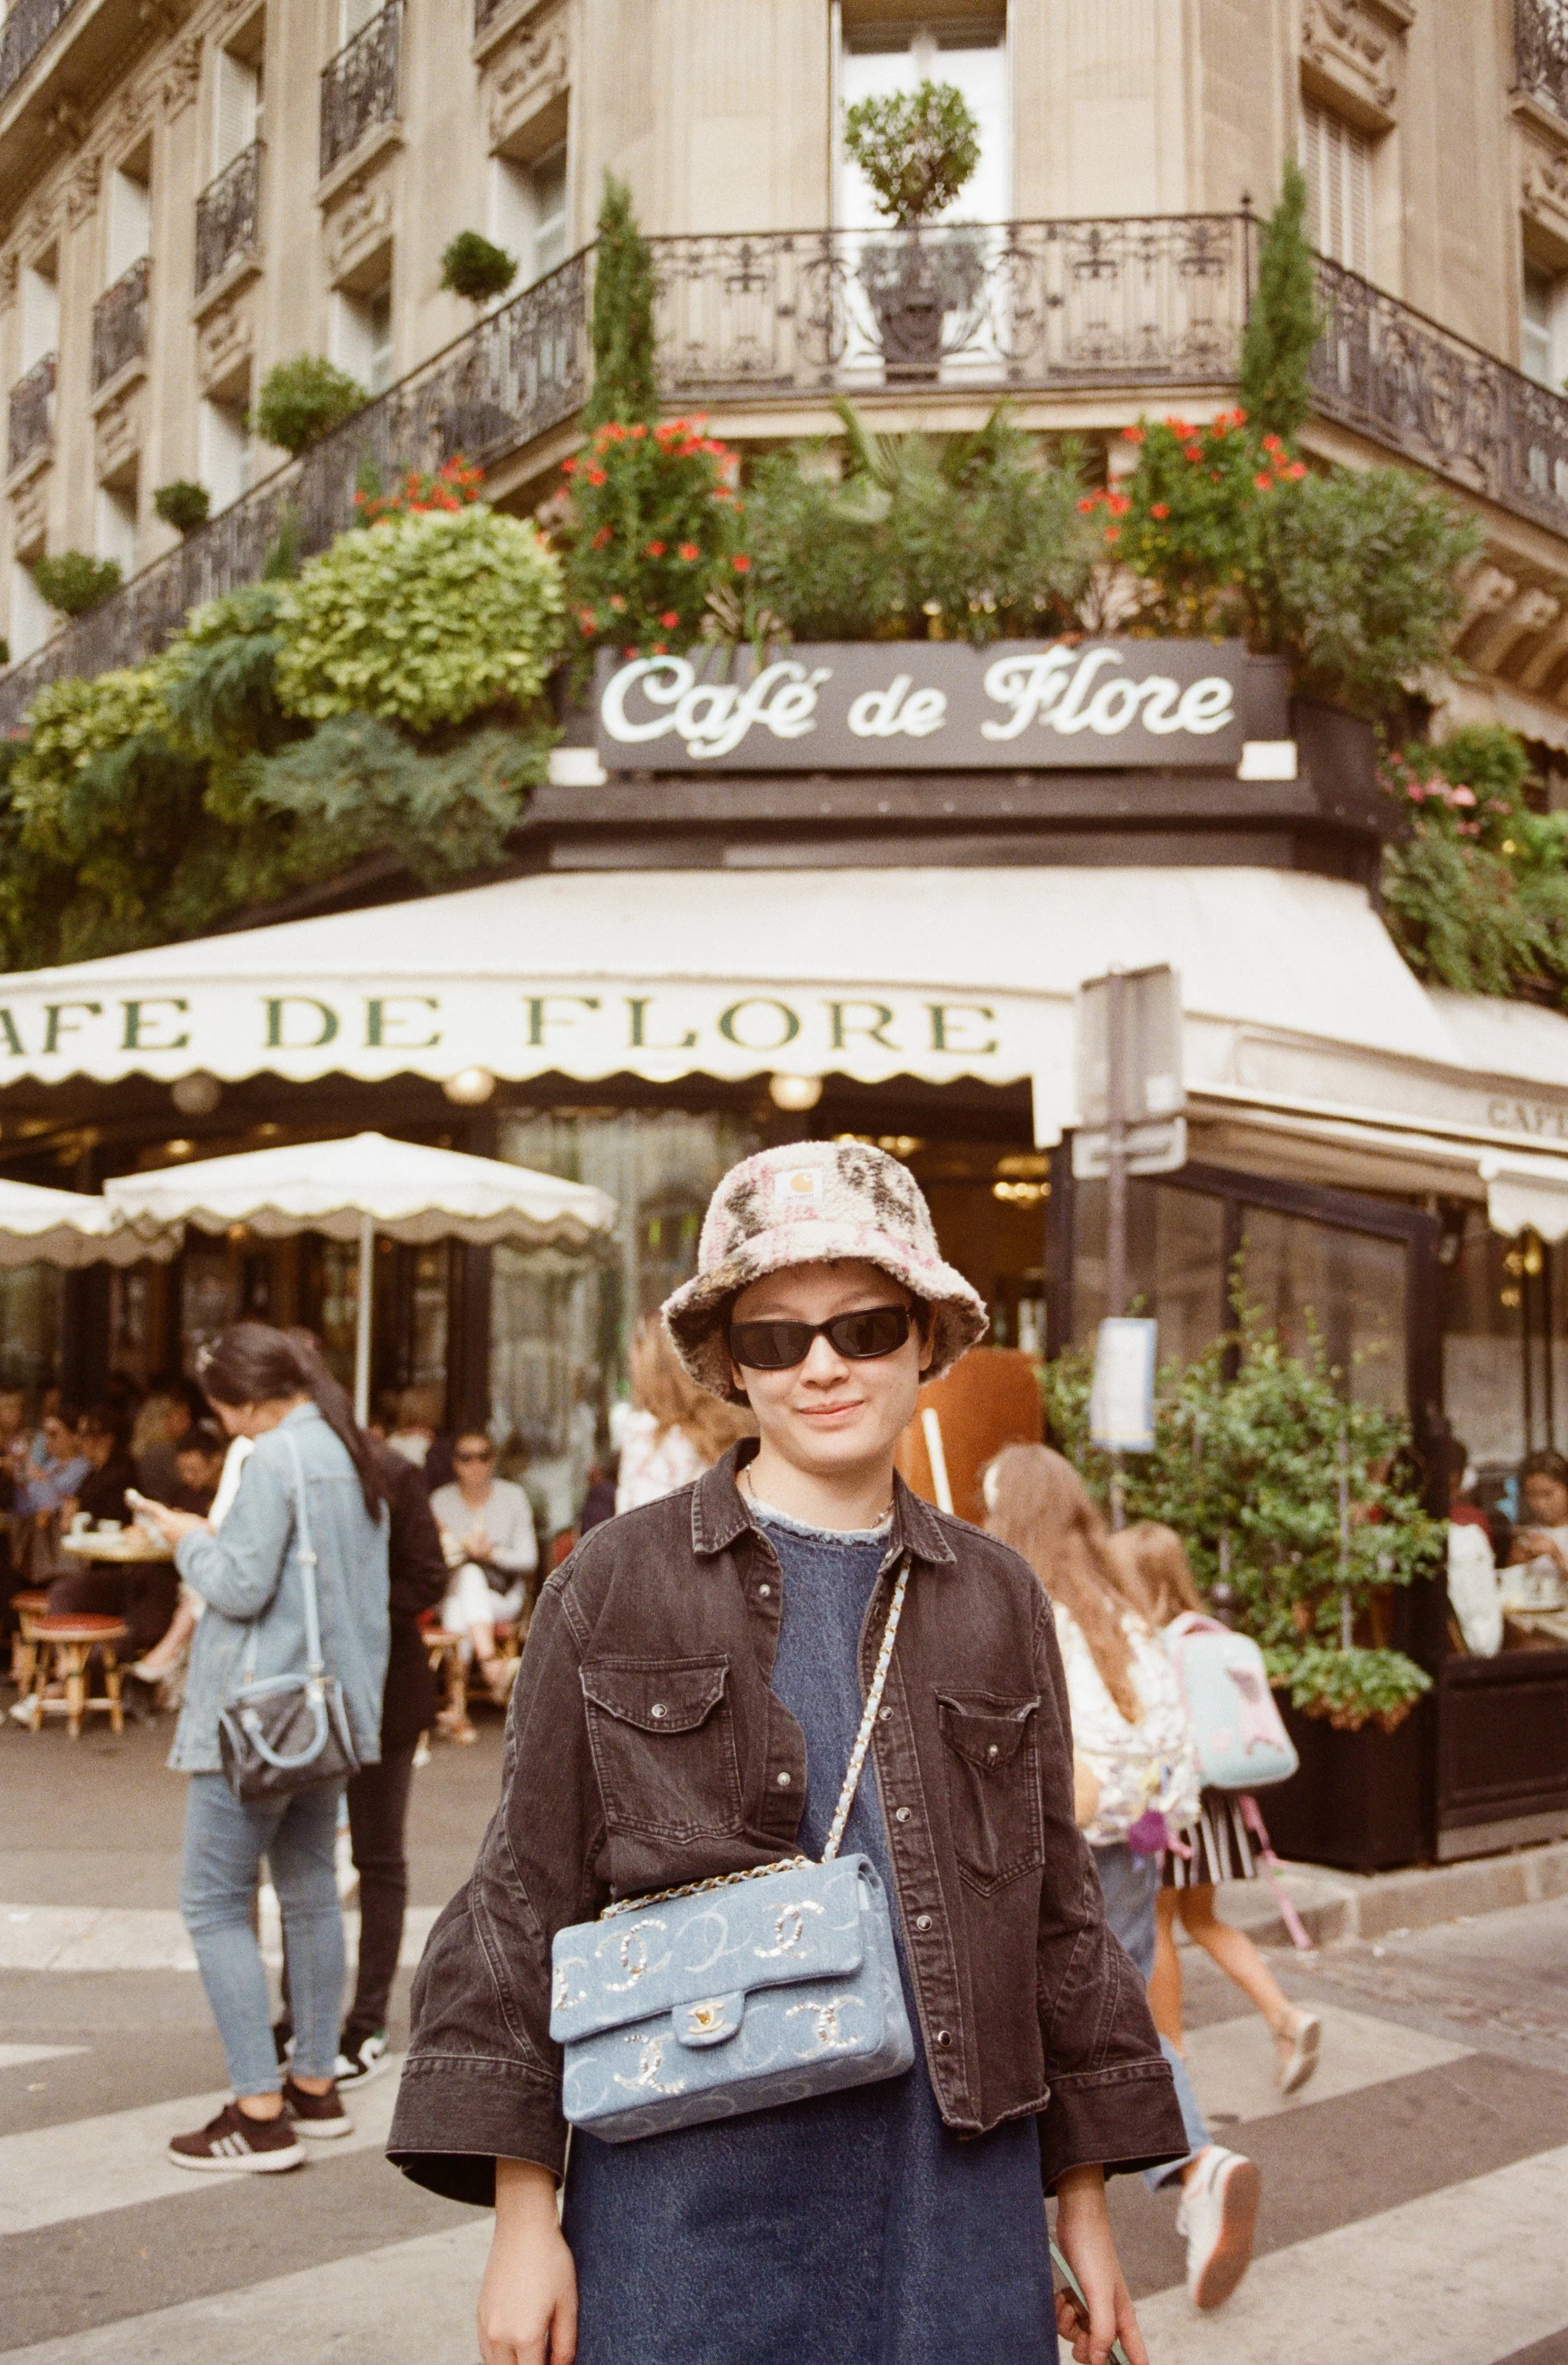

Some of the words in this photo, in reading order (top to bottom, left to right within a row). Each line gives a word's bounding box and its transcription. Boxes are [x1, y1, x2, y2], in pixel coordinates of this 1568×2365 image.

[599, 654, 832, 760] Café
[847, 673, 948, 738] de
[980, 646, 1236, 742] Flore
[258, 995, 443, 1050] DE
[522, 995, 1000, 1055] FLORE
